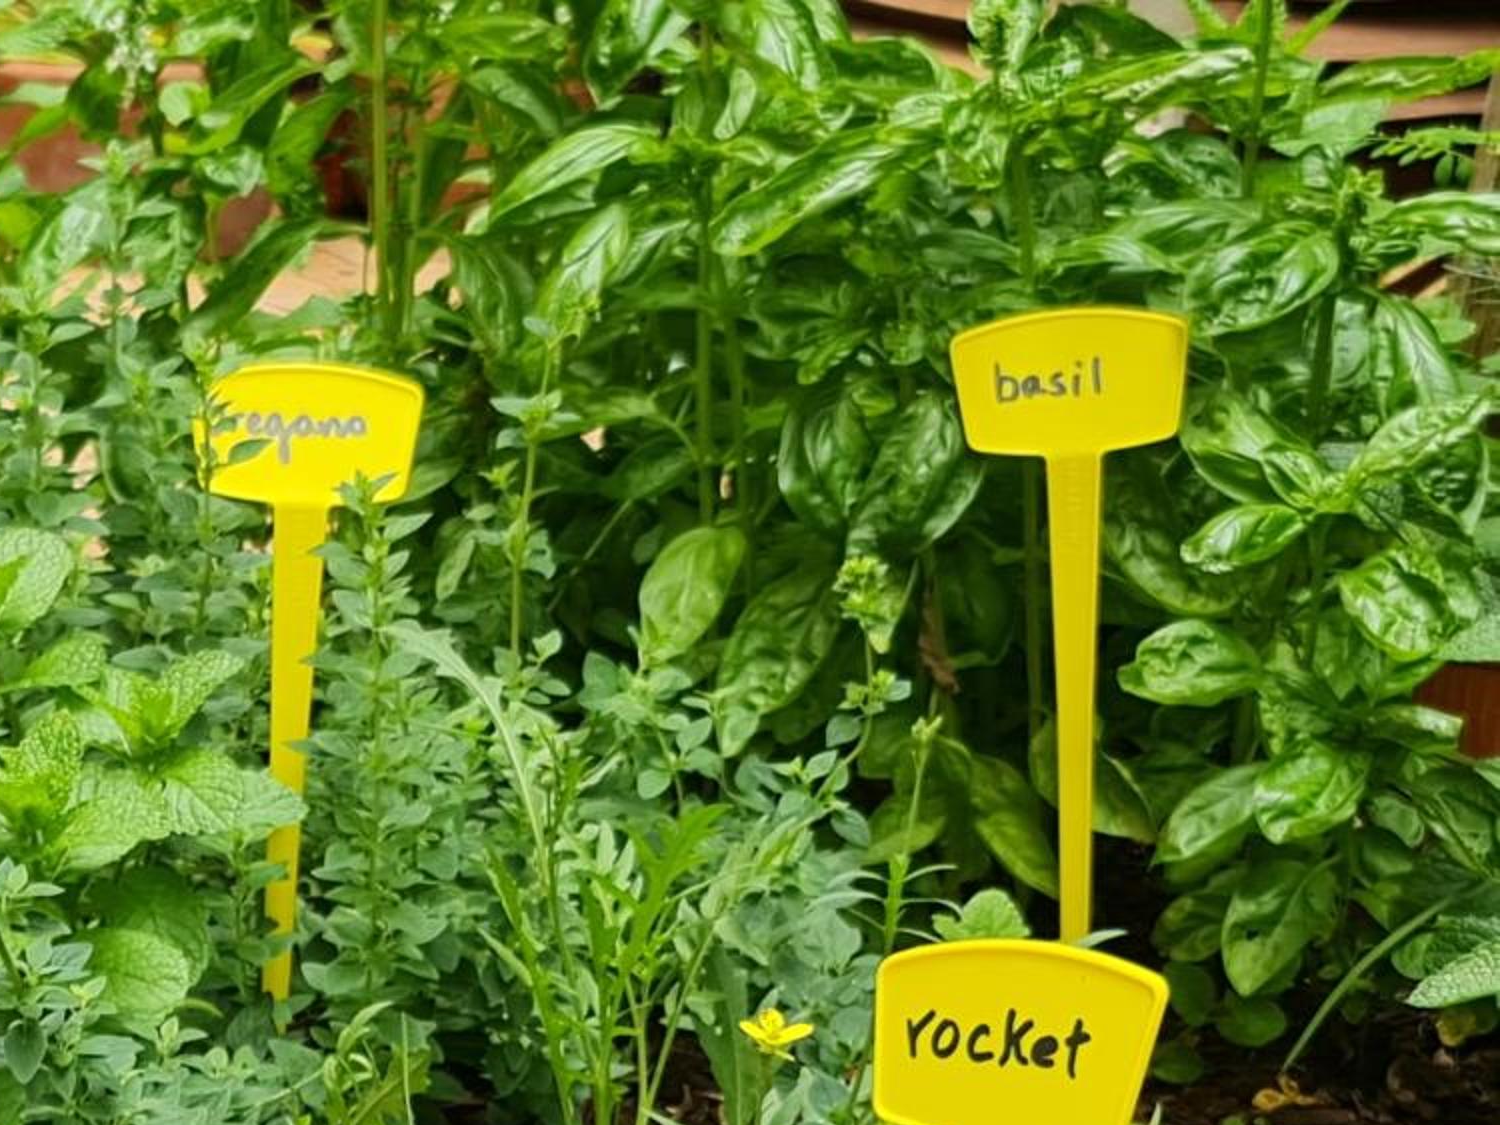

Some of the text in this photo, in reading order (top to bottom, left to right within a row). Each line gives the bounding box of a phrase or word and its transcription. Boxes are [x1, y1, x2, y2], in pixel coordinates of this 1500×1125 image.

[993, 355, 1102, 405] basil
[211, 411, 368, 465] regano
[906, 1007, 1092, 1080] rocket
